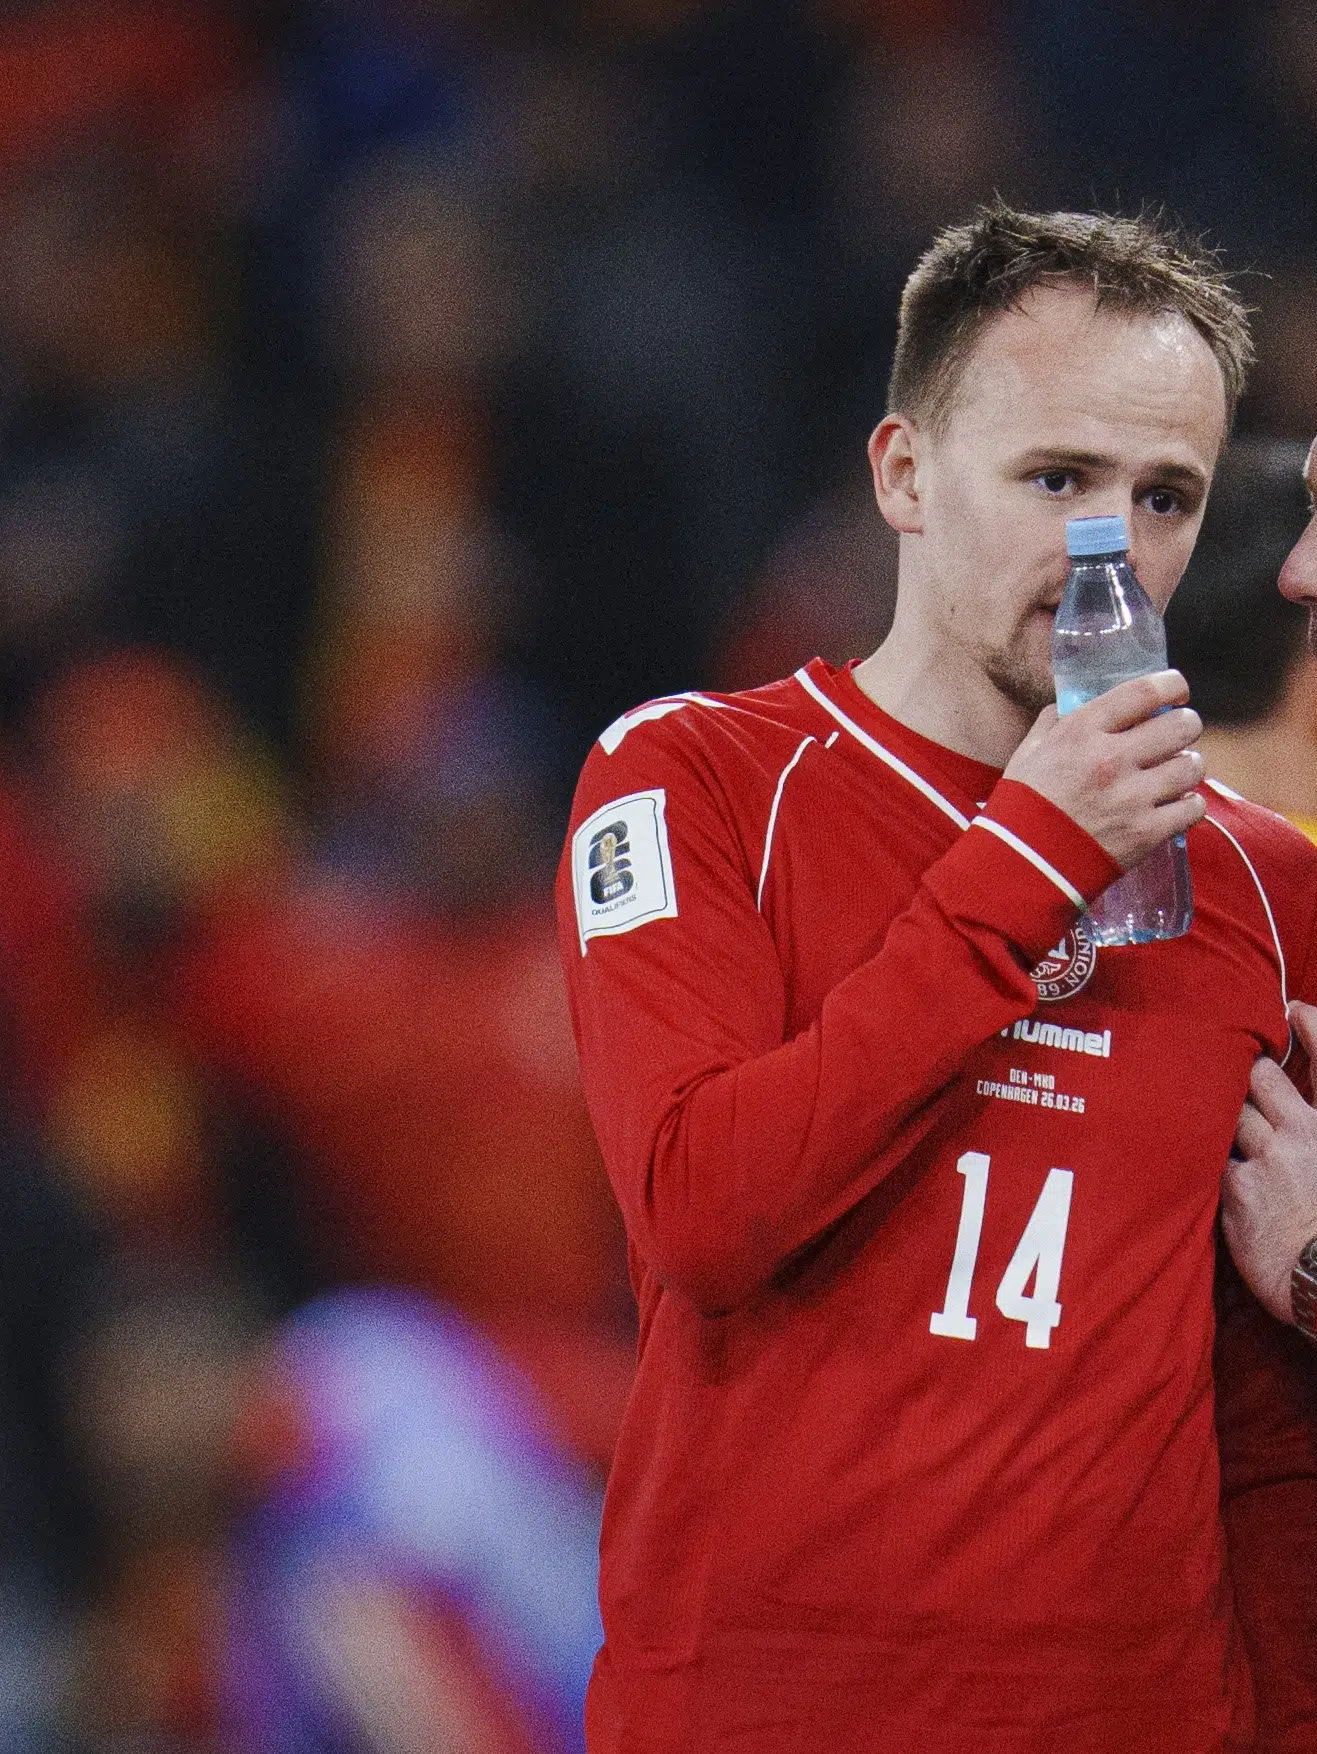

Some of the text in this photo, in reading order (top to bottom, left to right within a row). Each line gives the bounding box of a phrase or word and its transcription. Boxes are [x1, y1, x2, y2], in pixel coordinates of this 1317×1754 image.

[603, 881, 624, 898] FIFA
[591, 894, 637, 916] QUALIFIERS
[1037, 983, 1060, 996] 89
[976, 1079, 1086, 1114] COPENHAGEN 26.03.26
[929, 1151, 1075, 1350] 14
